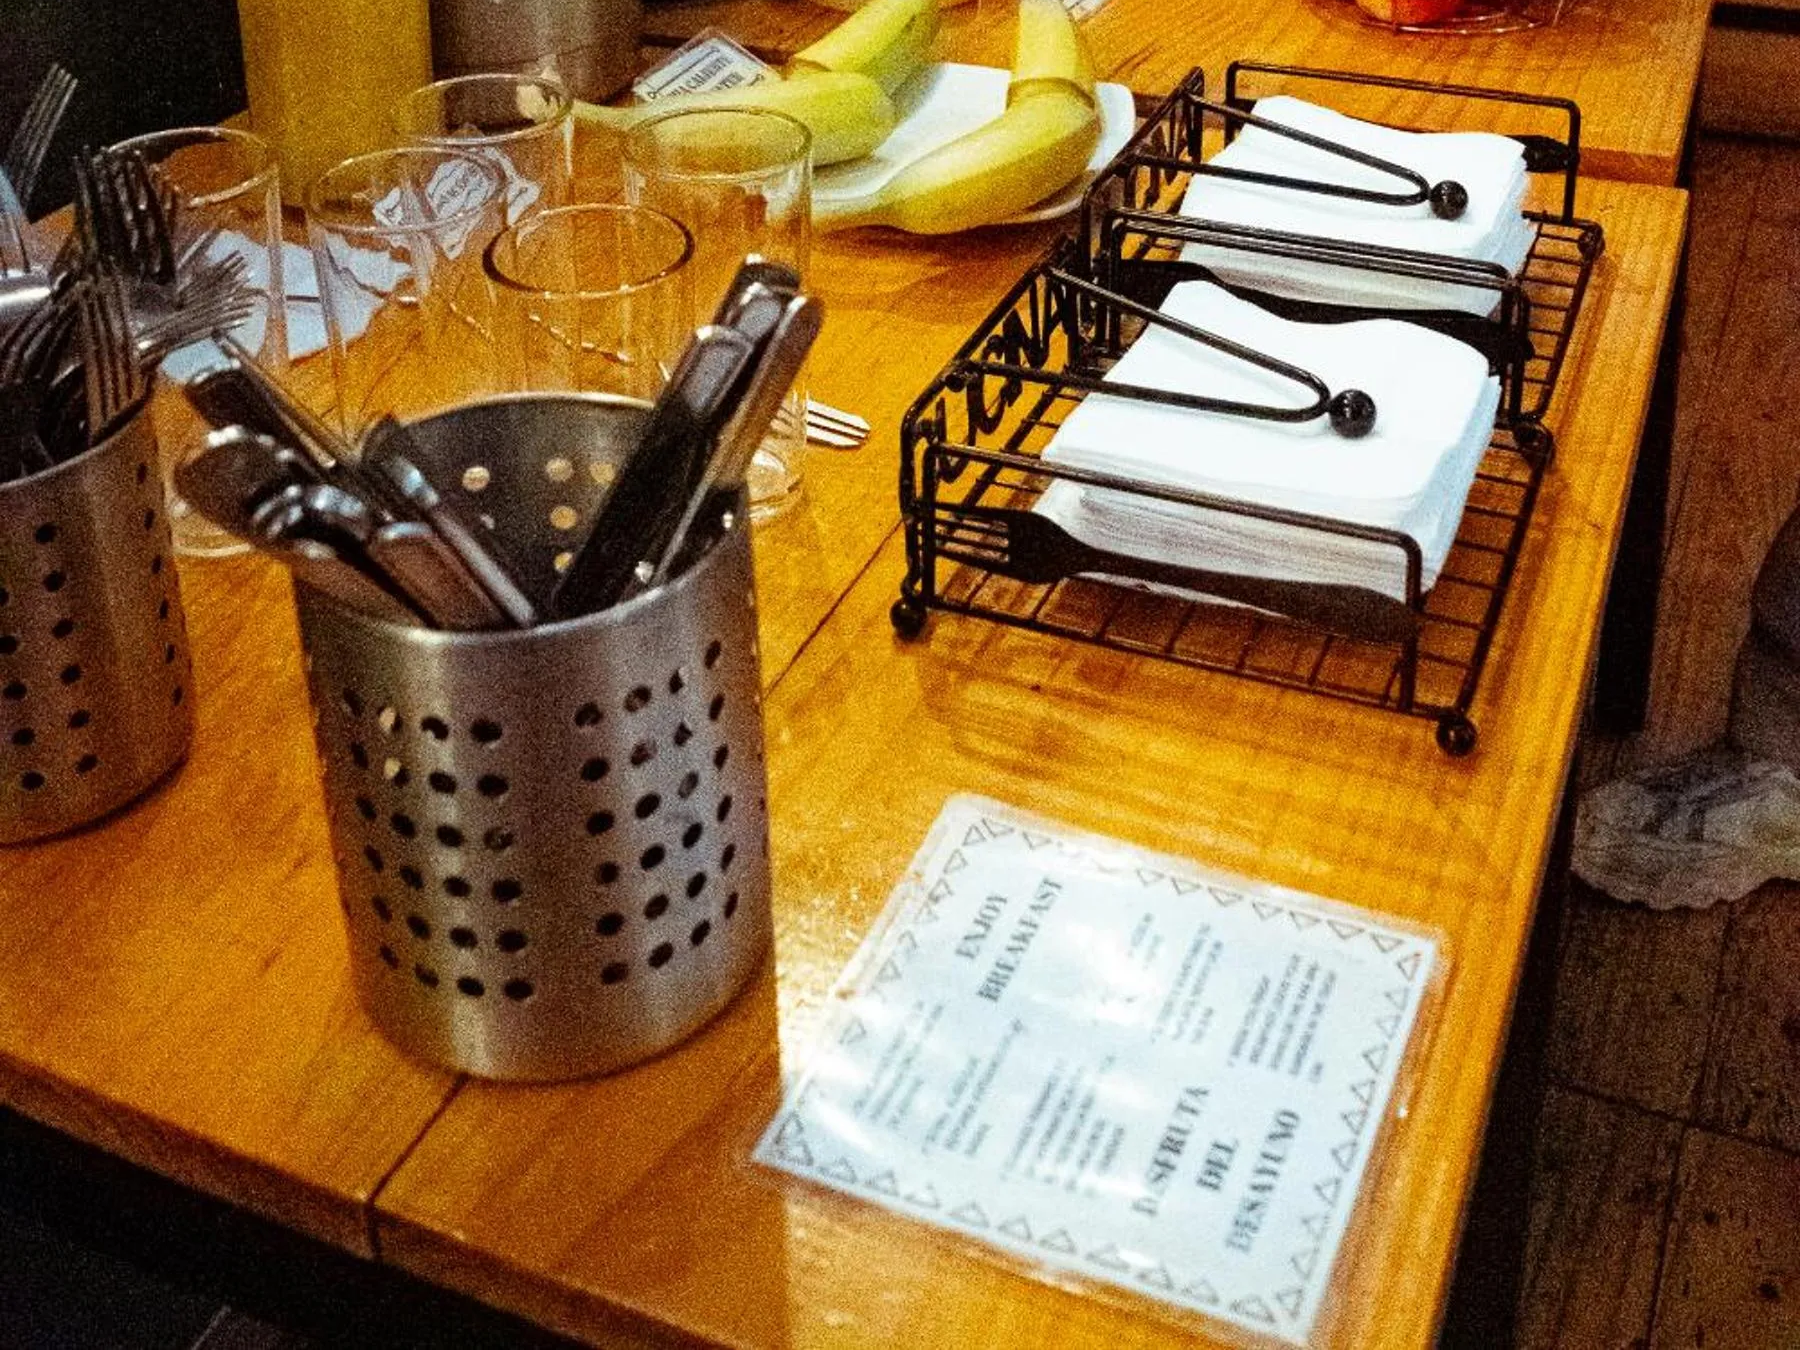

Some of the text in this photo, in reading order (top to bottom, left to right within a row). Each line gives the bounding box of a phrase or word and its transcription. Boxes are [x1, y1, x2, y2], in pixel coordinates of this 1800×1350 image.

[954, 894, 1008, 960] ENJOY
[975, 875, 1063, 1003] BREAKFAST
[1195, 1138, 1240, 1192] DEL
[1224, 1107, 1301, 1254] DESAYUNO
